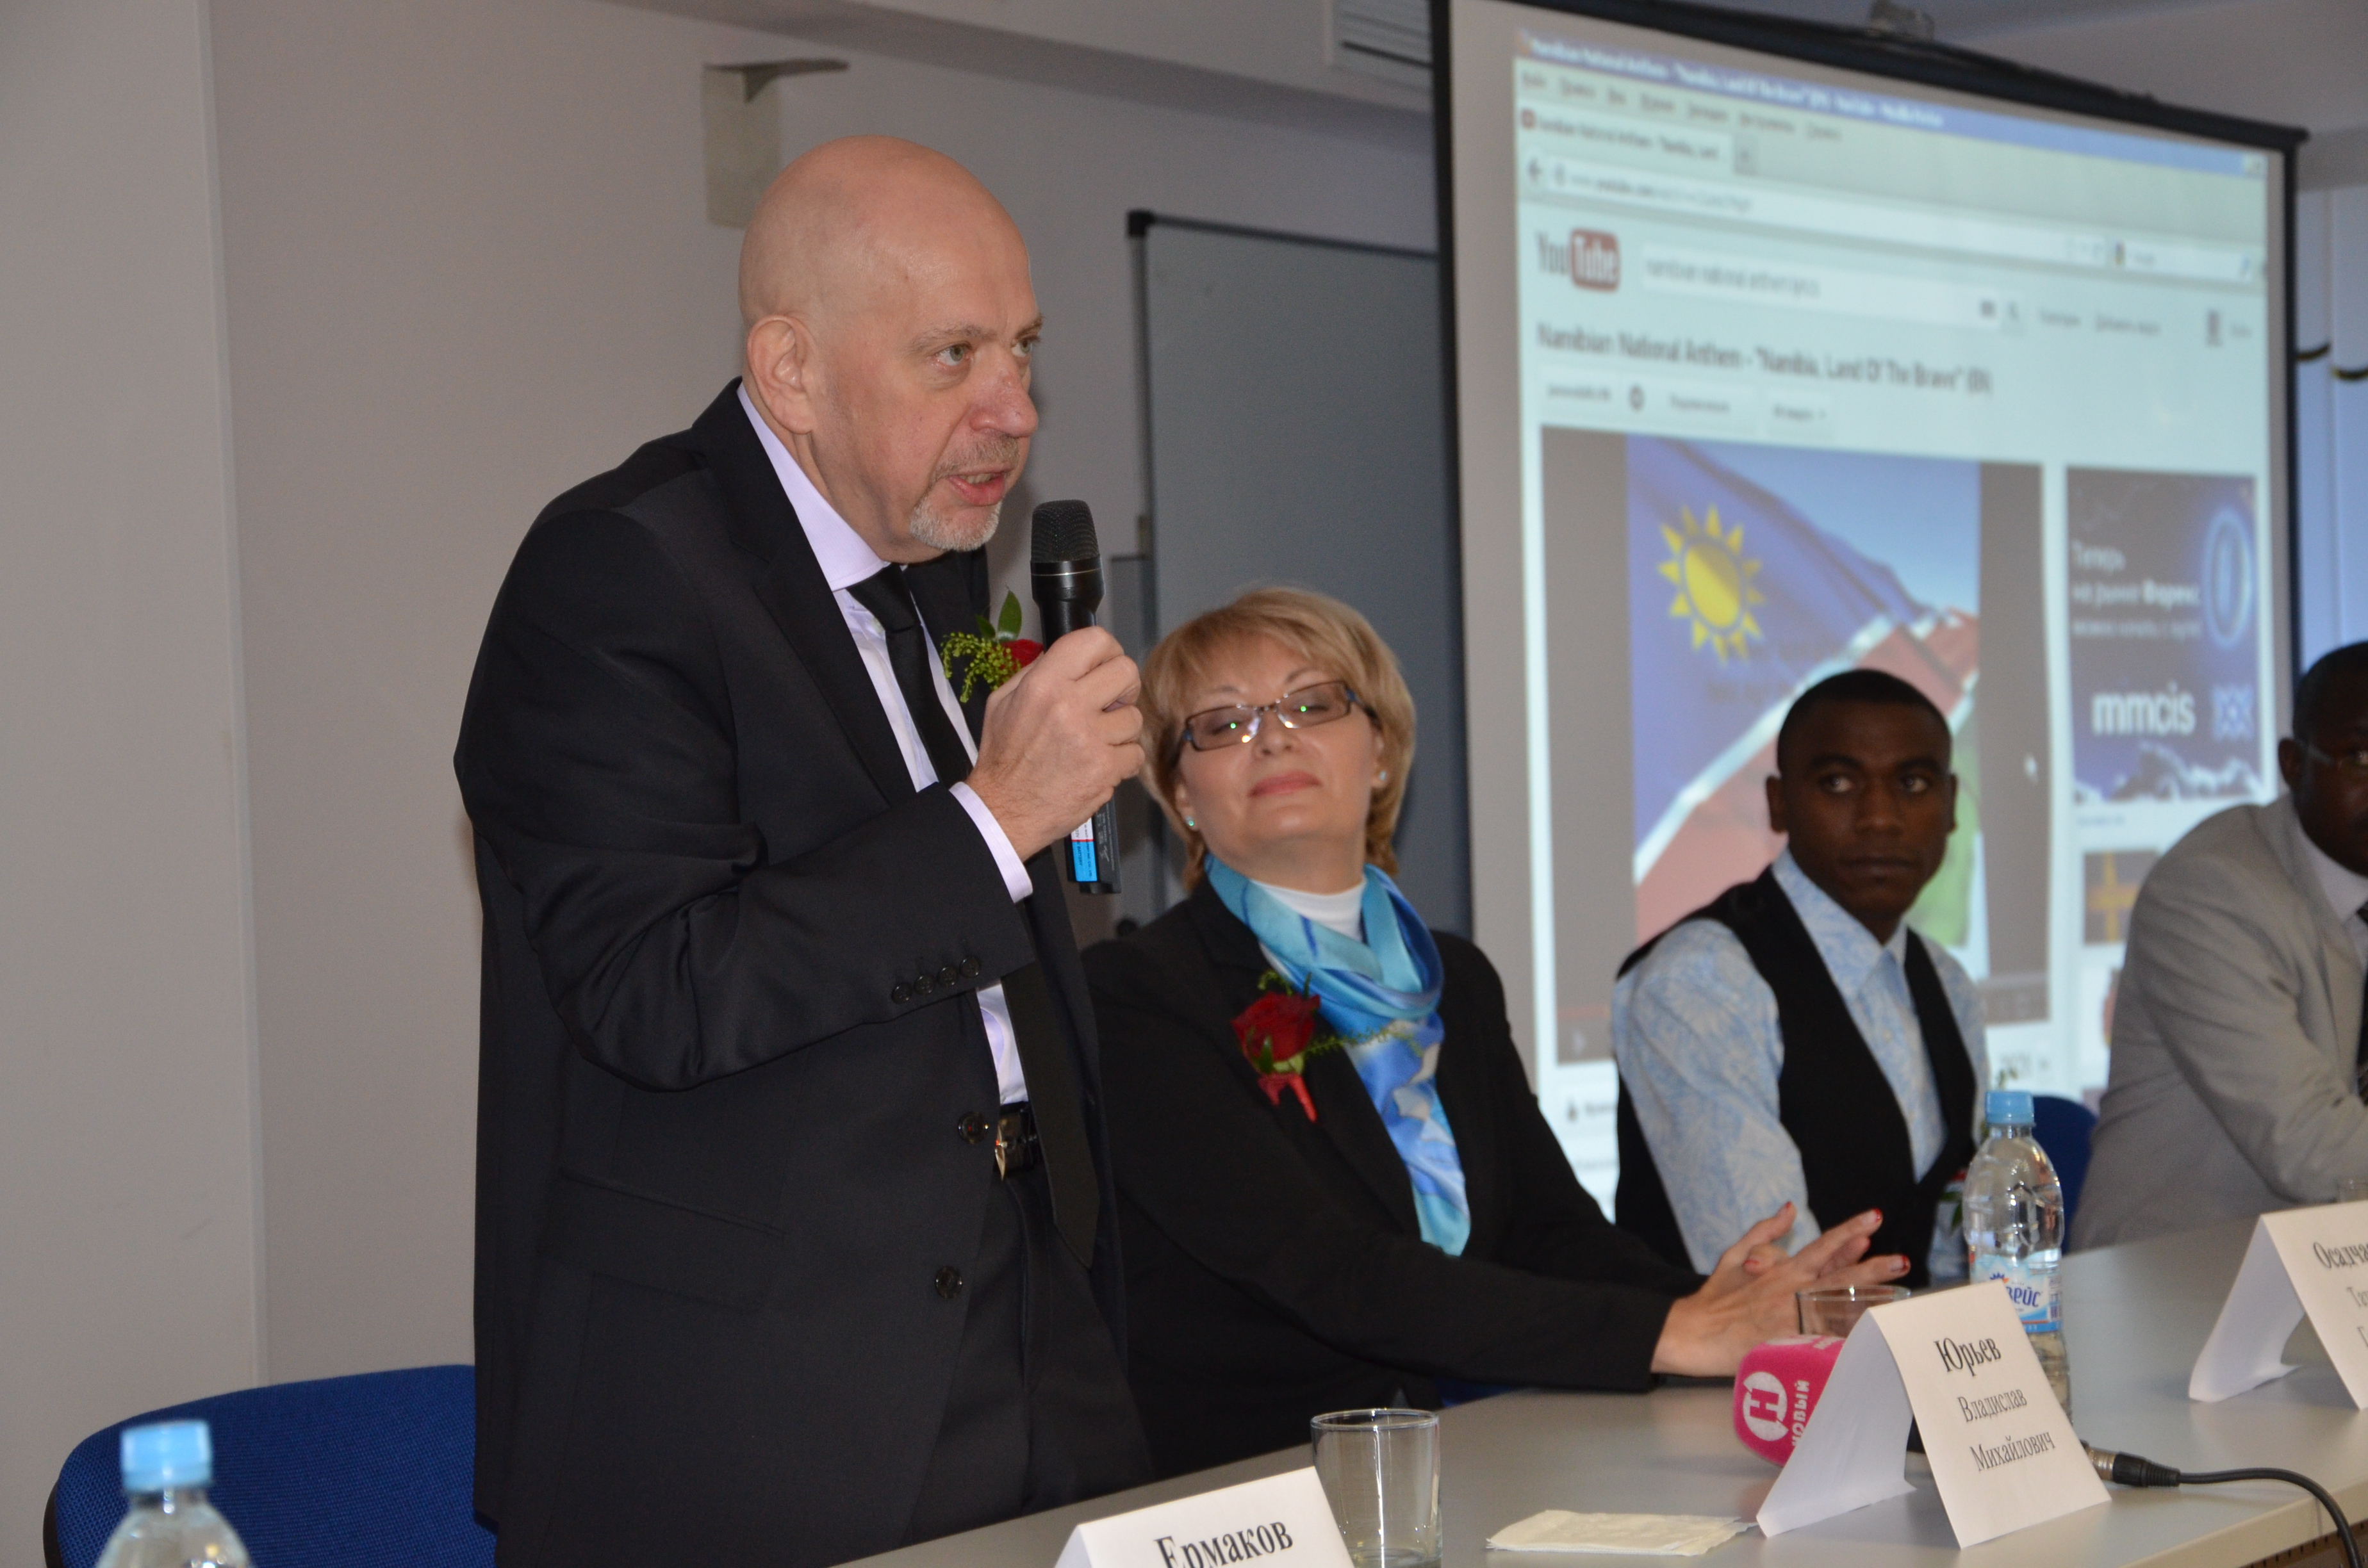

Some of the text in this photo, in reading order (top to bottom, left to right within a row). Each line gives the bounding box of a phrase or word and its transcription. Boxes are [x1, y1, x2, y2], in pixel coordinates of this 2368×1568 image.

[1536, 230, 1620, 288] YouTube
[2091, 681, 2196, 736] mmcis
[1934, 1337, 2002, 1377] Юрьев
[1957, 1389, 2027, 1423] Владислав
[1969, 1432, 2056, 1472] Михайлович
[1153, 1521, 1294, 1568] Ермаков
